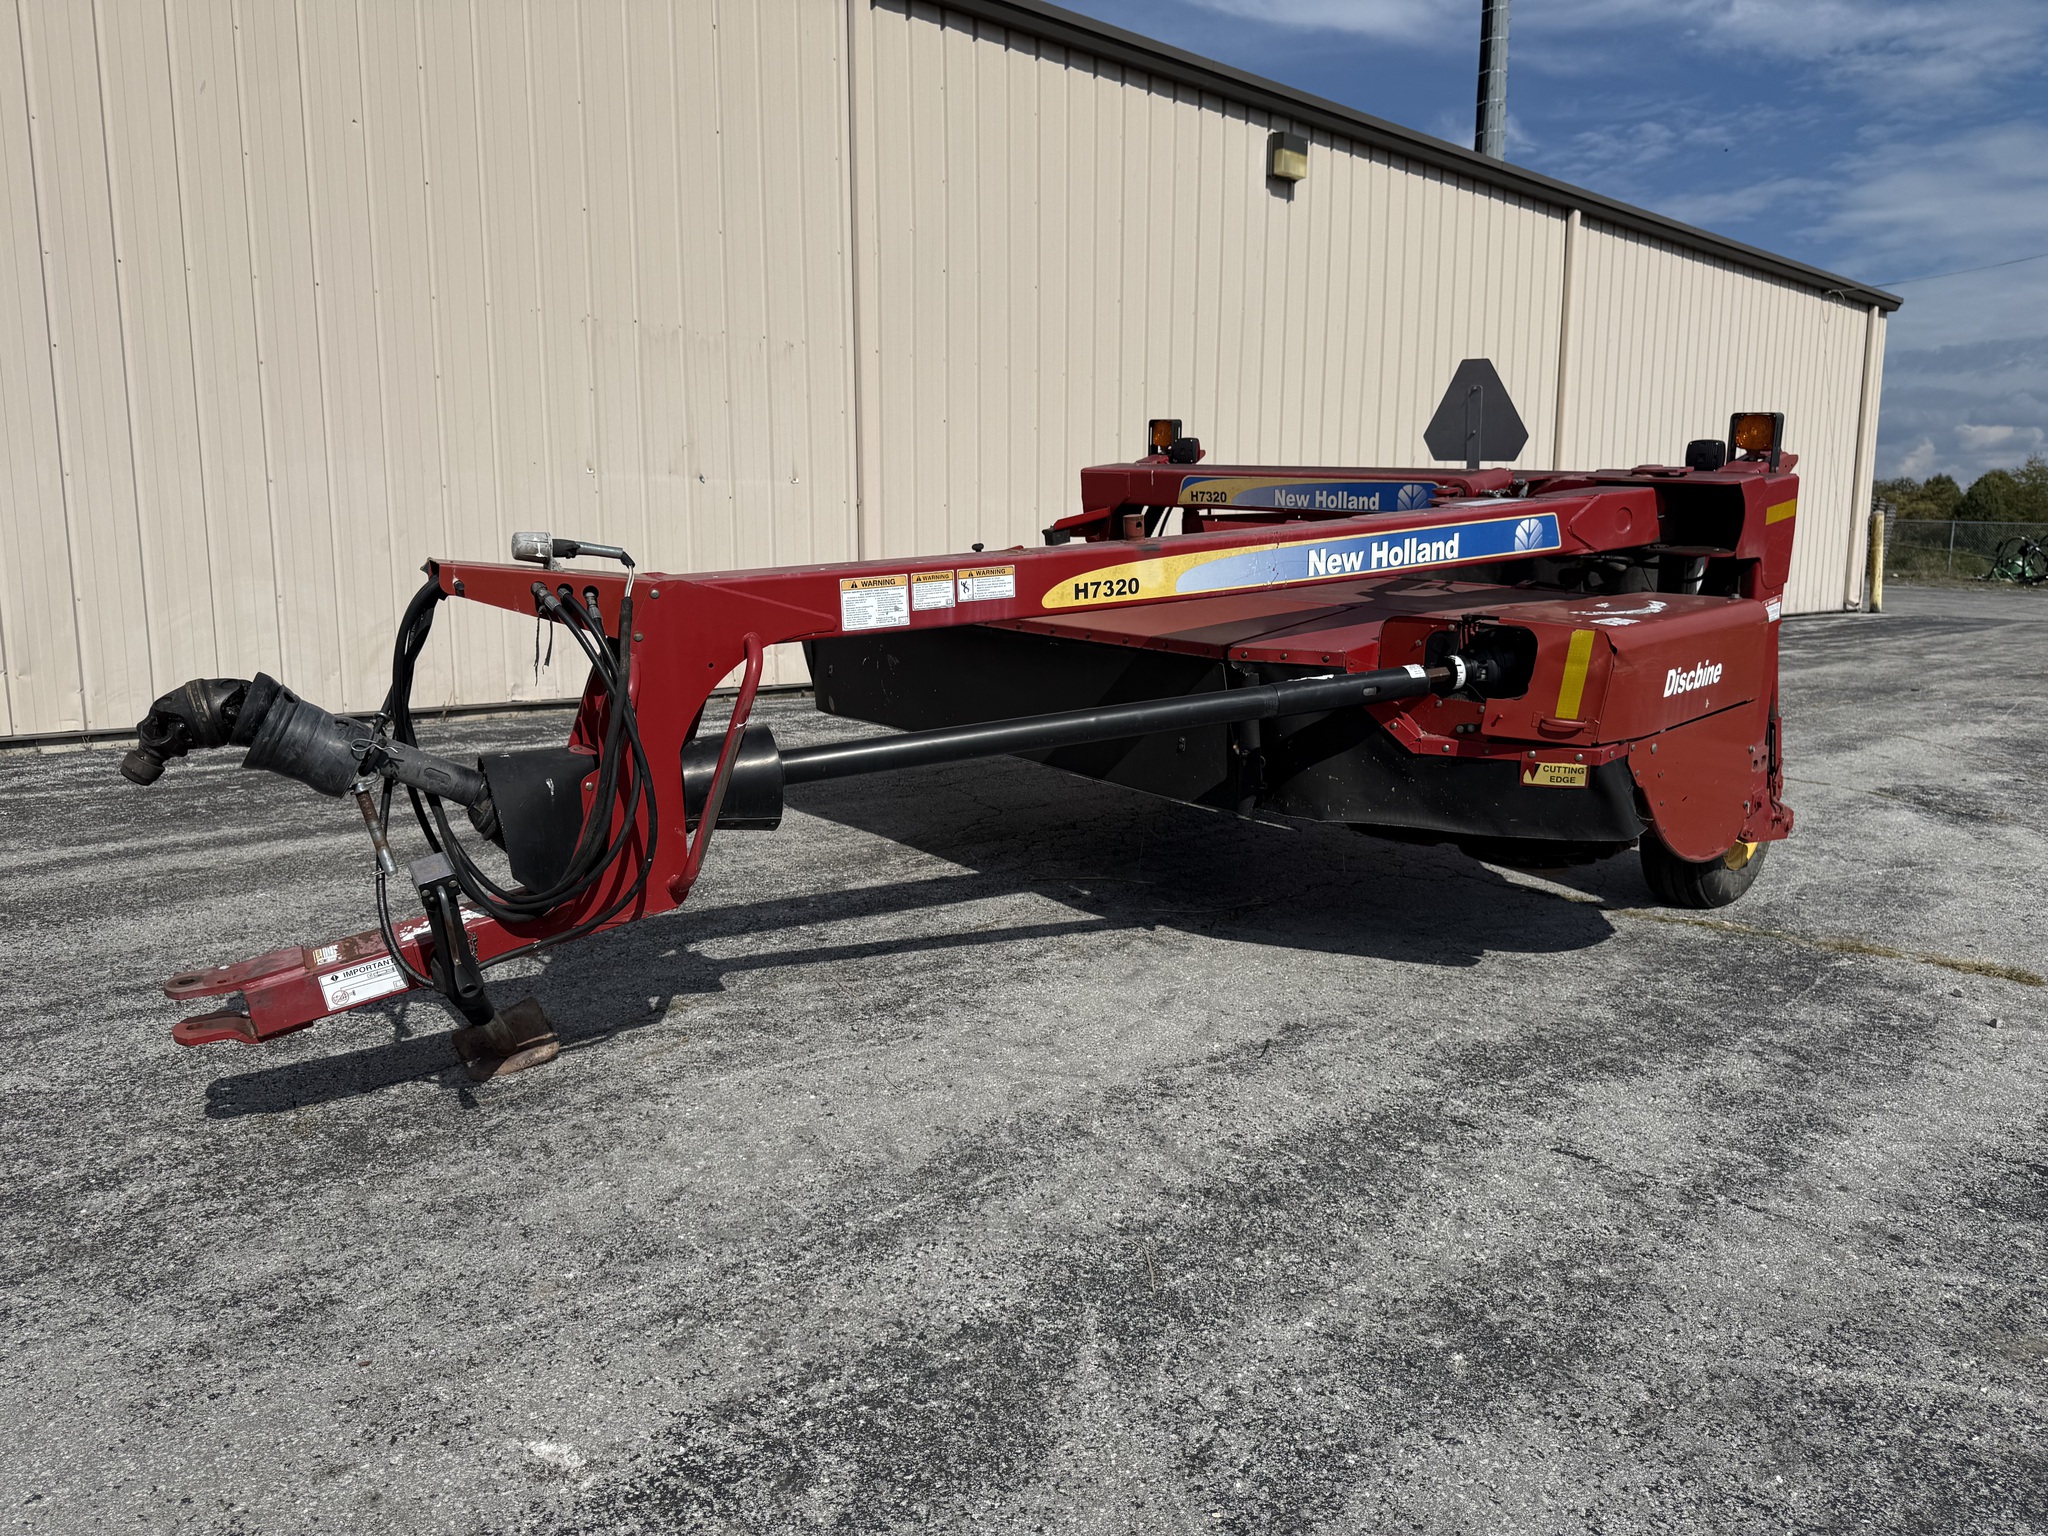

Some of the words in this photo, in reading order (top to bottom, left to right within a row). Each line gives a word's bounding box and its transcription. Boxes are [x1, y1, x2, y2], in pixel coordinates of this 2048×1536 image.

[1190, 490, 1227, 503] H7320
[1274, 489, 1310, 507] New
[1315, 490, 1380, 511] Holland
[1307, 548, 1364, 577] New
[1370, 532, 1460, 569] Holland
[922, 573, 950, 581] WARNING
[975, 568, 1006, 576] WARNING
[860, 578, 896, 588] WARNING
[1074, 577, 1140, 600] H7320
[1663, 659, 1723, 698] Discbine
[1542, 765, 1585, 775] CUTTING
[1549, 775, 1576, 784] EDGE
